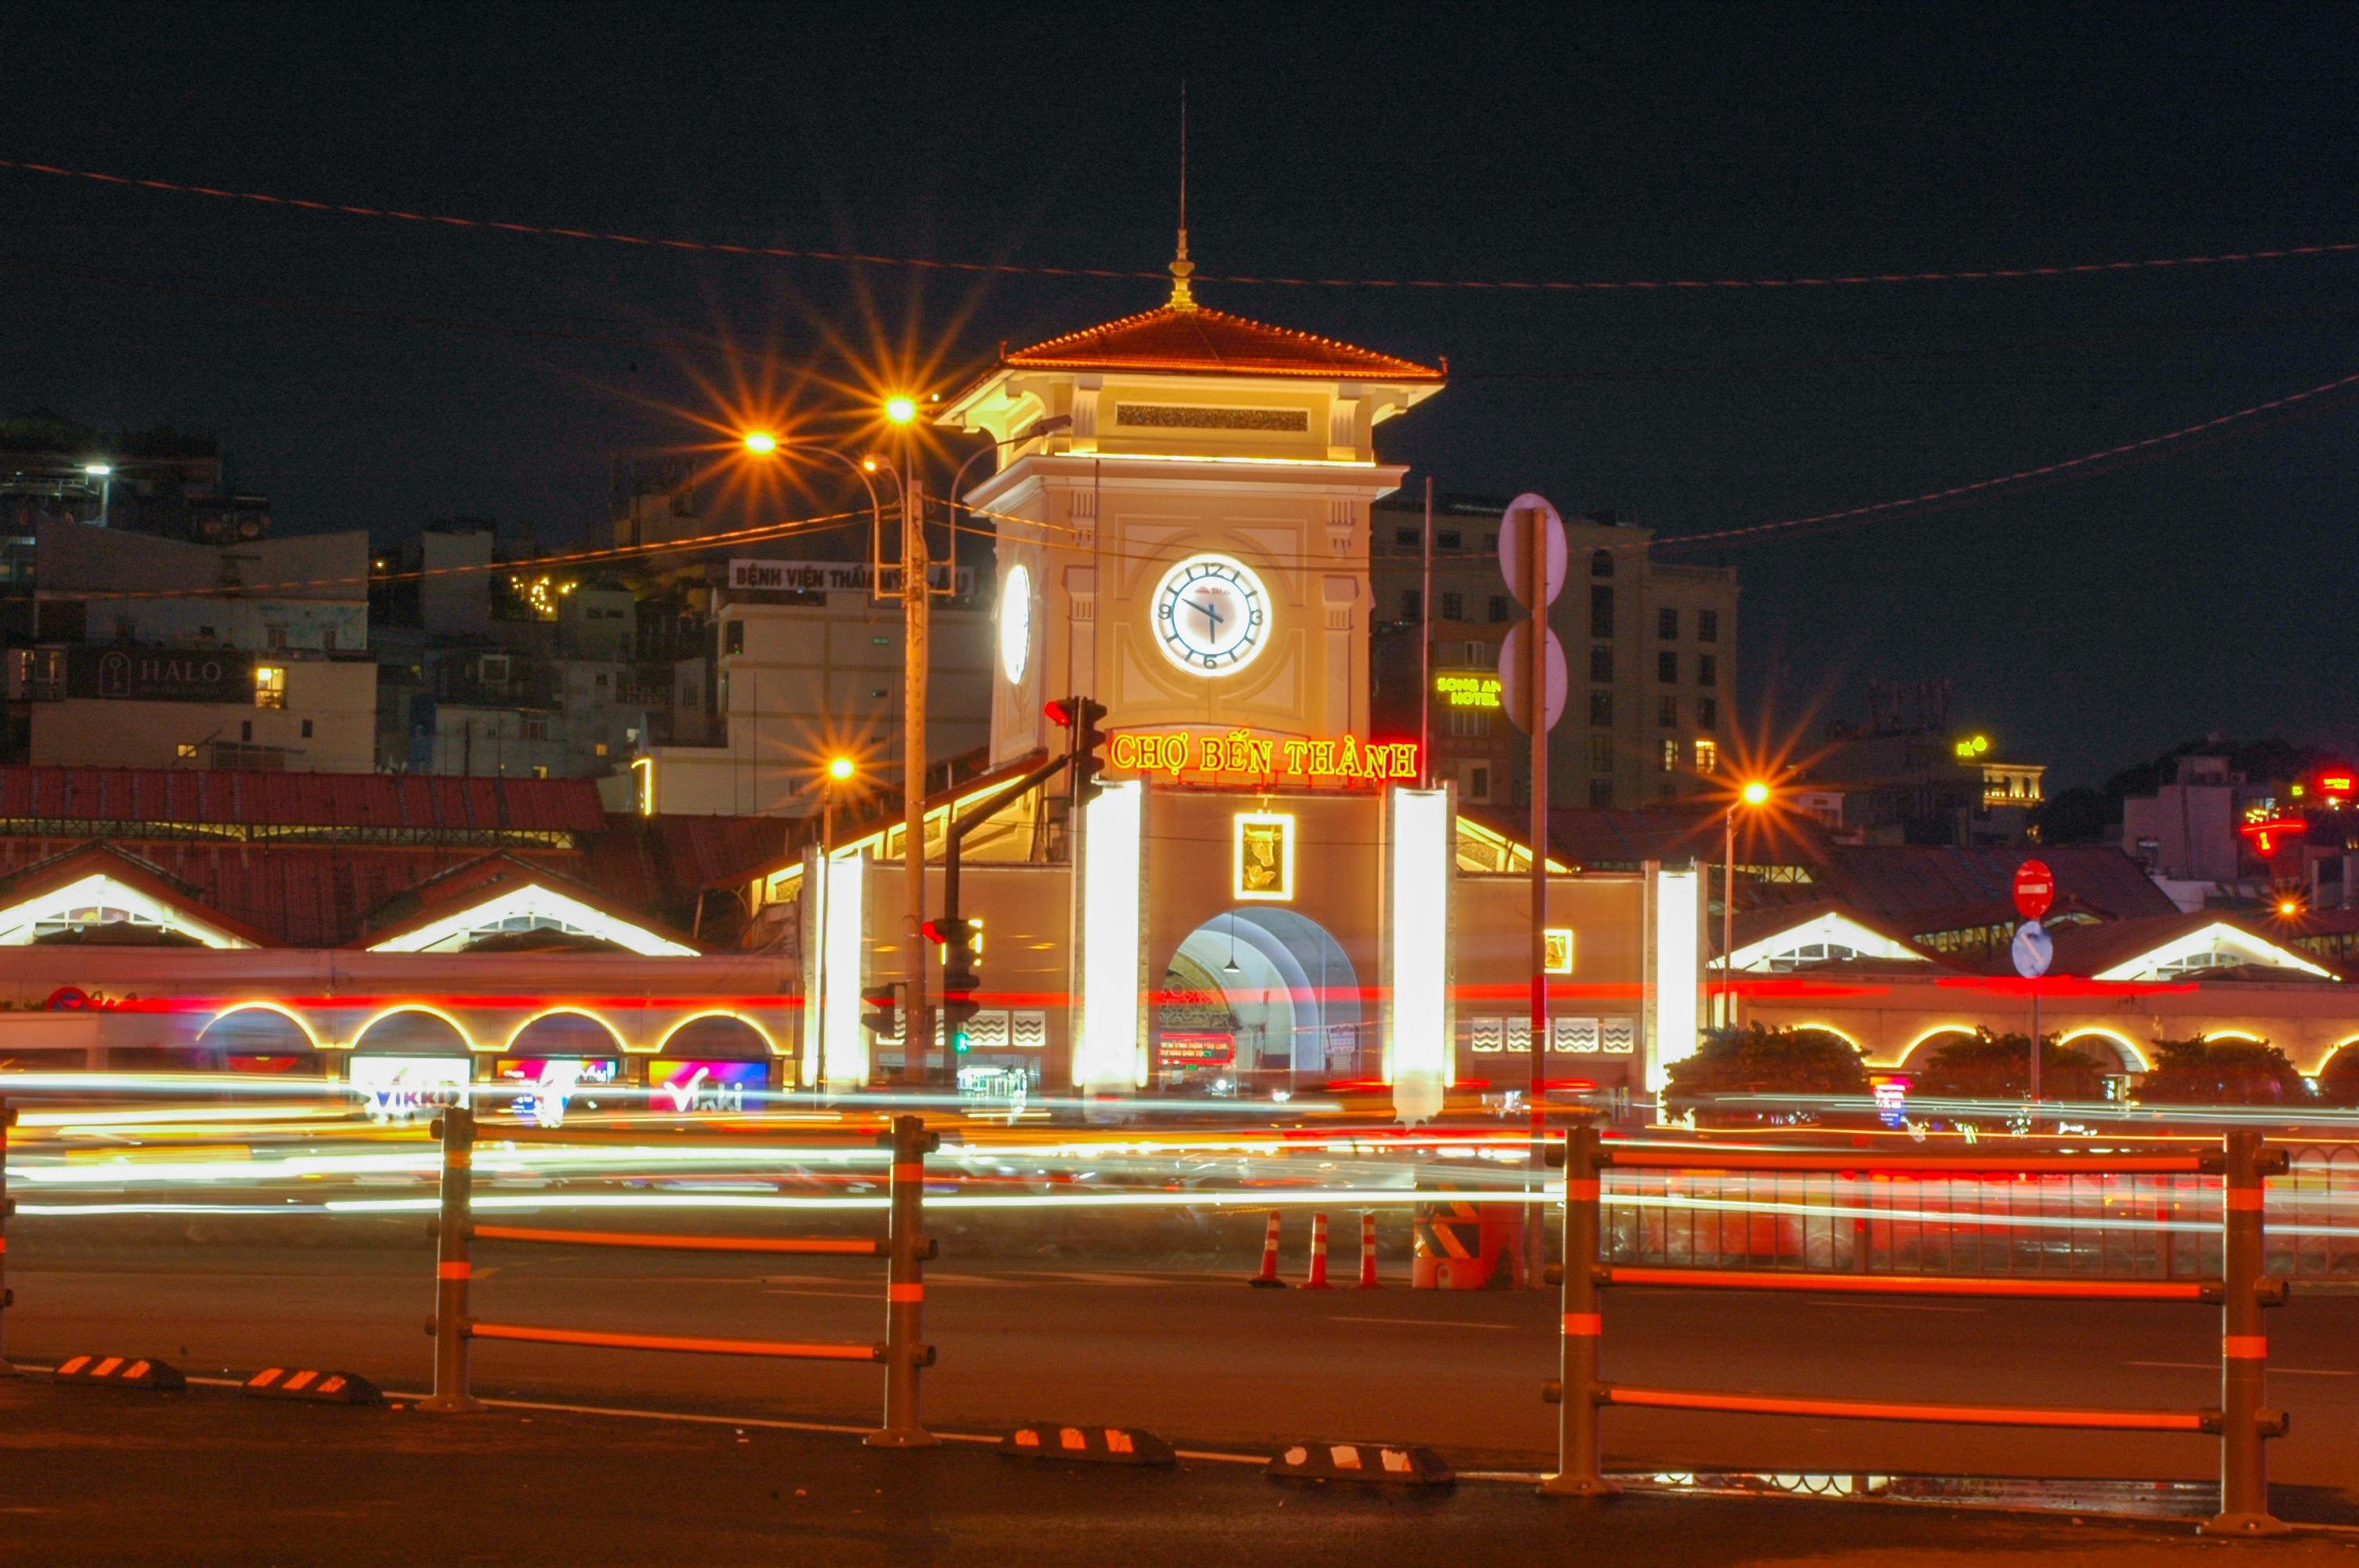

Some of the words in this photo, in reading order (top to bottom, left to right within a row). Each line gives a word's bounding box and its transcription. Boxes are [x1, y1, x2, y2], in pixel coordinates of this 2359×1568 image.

[736, 563, 782, 587] BỆNH
[787, 565, 824, 589] VIỆN
[1203, 562, 1224, 578] 12
[1158, 604, 1172, 620] 9
[1251, 609, 1263, 626] 3
[1203, 654, 1217, 670] 6
[140, 659, 223, 682] HALO
[1437, 677, 1479, 691] SONG
[1451, 691, 1500, 706] HOTEL
[1110, 731, 1189, 775] CHỢ
[1199, 728, 1273, 774] BẾN
[1284, 734, 1417, 779] THÀNH
